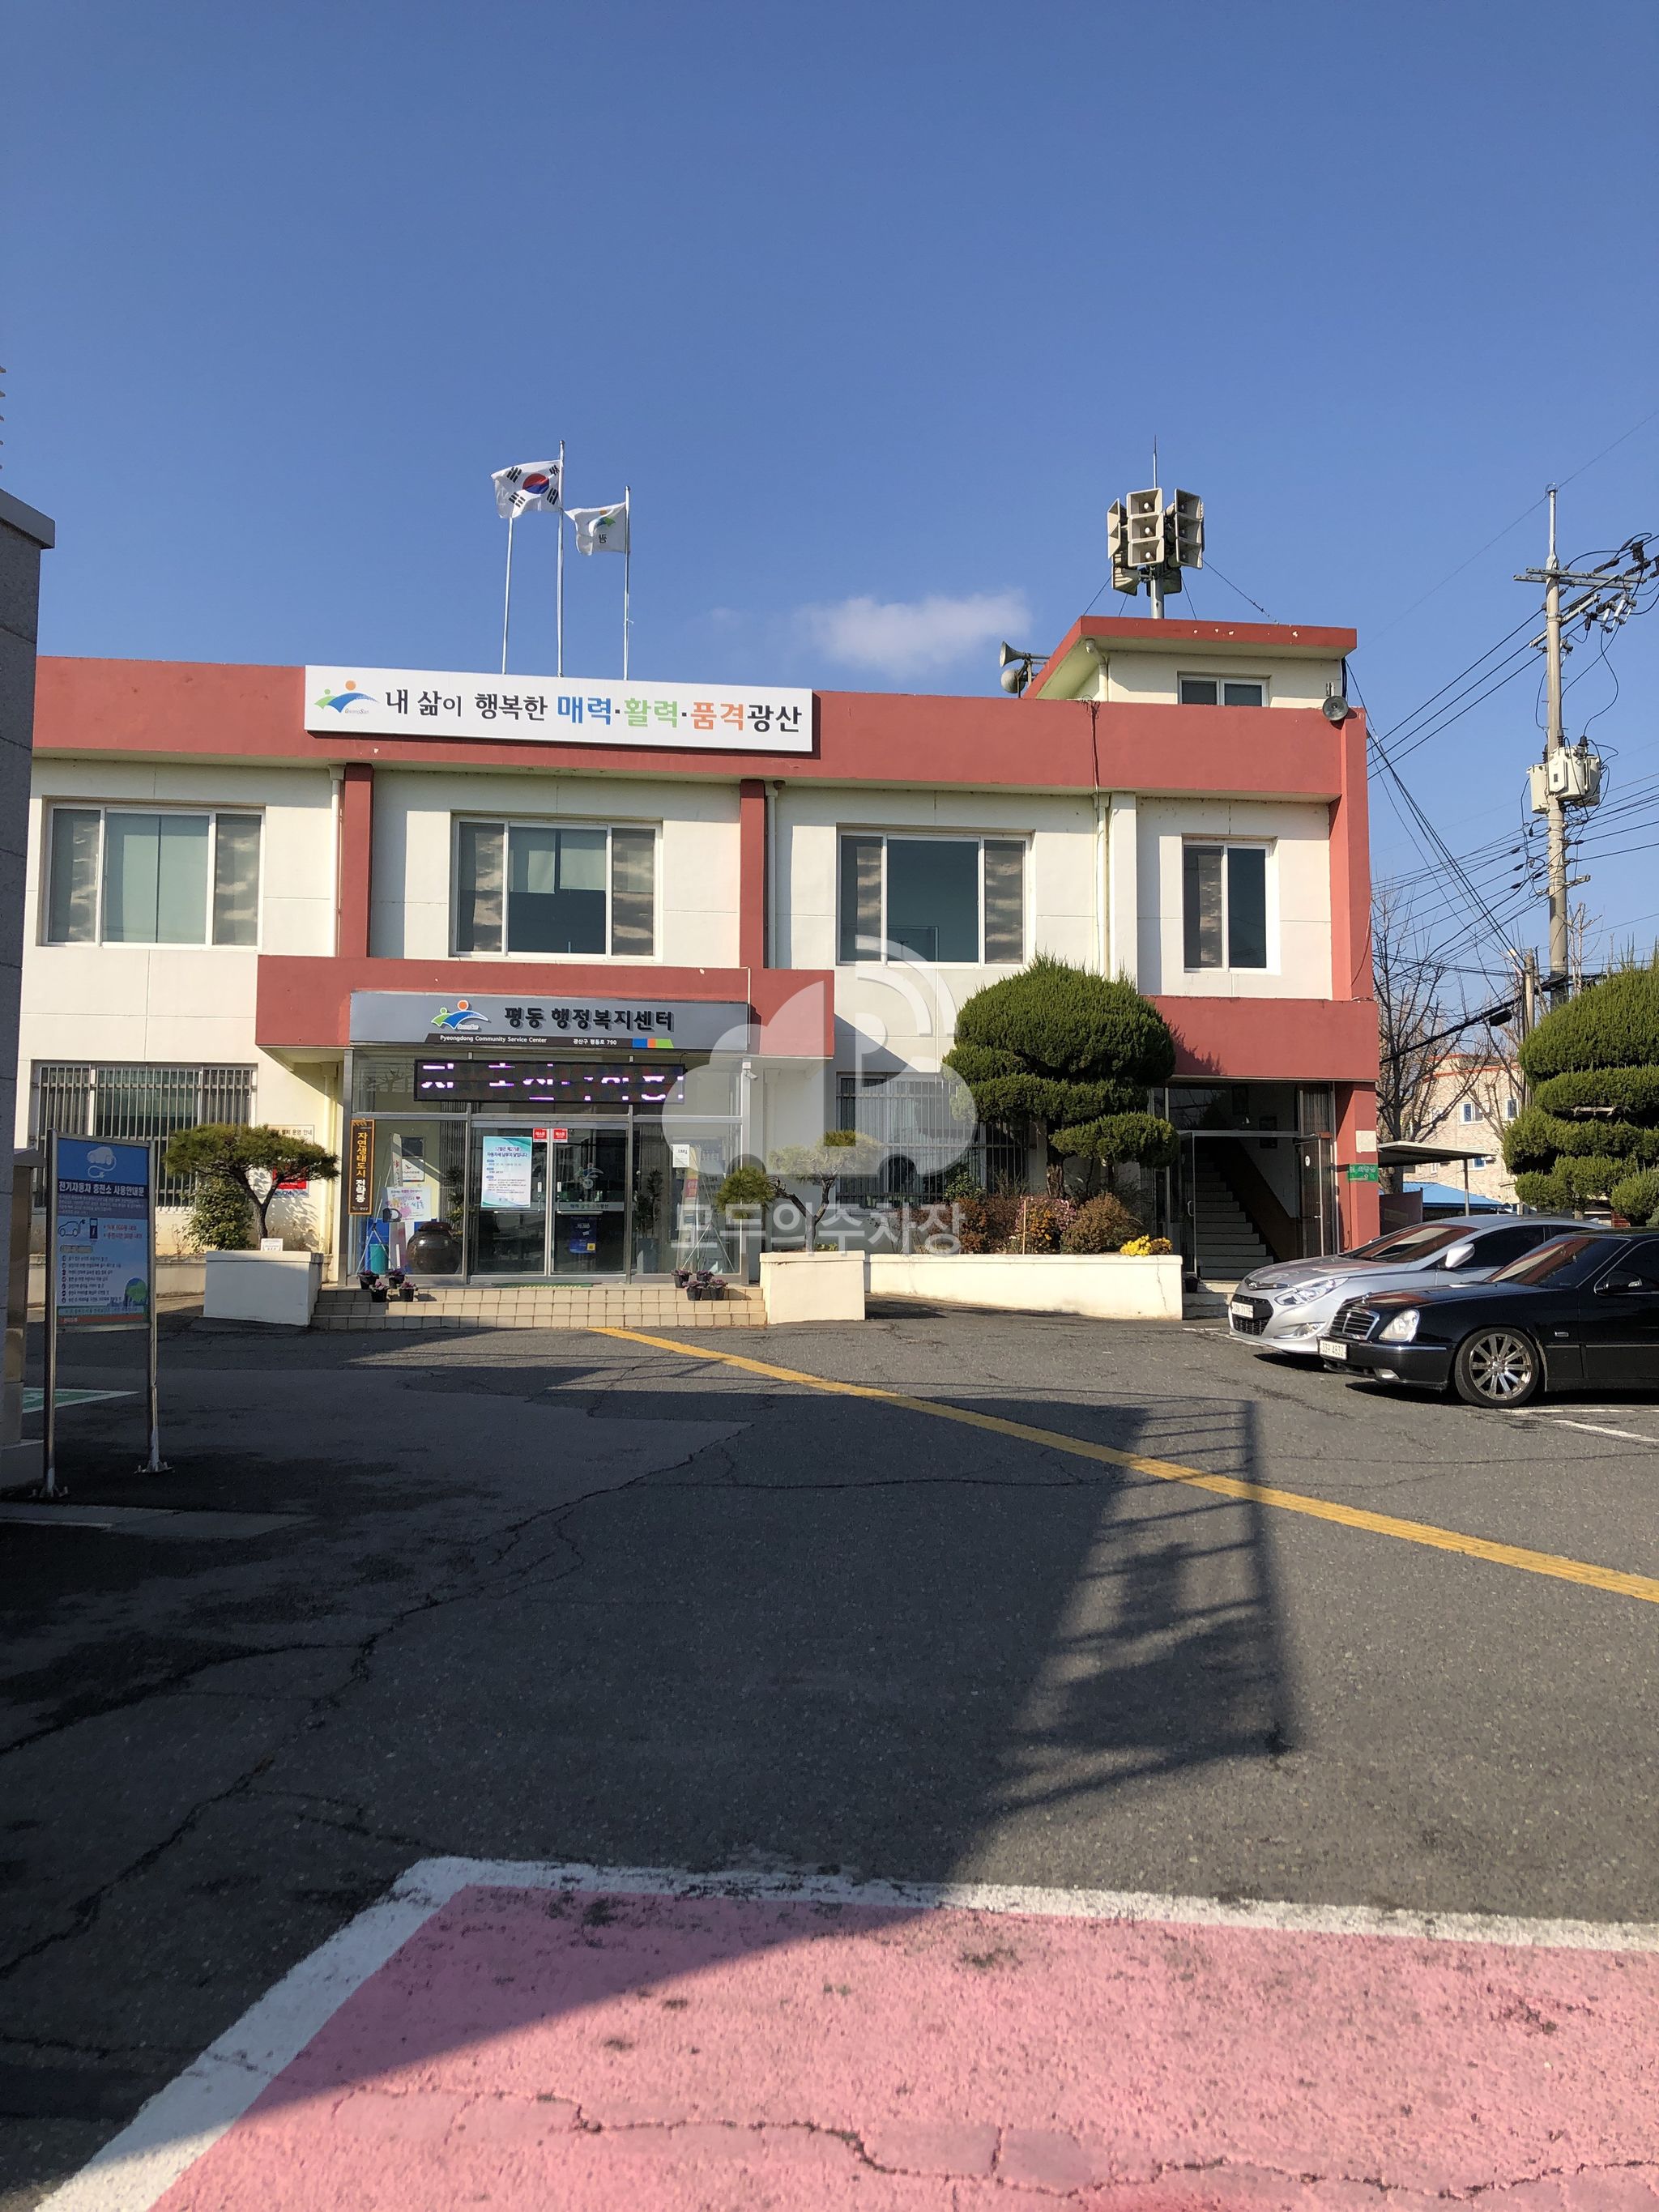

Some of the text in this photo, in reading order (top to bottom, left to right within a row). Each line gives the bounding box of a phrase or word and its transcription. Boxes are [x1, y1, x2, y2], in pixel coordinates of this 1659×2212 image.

[385, 689, 408, 715] 내
[417, 690, 463, 718] 삶이
[475, 693, 548, 722] 행복한
[504, 1007, 673, 1032] 평동 행정복지센터
[356, 1132, 368, 1178] 자연생태도시
[58, 1181, 144, 1197] 전기자동차 충전소 사용안내문
